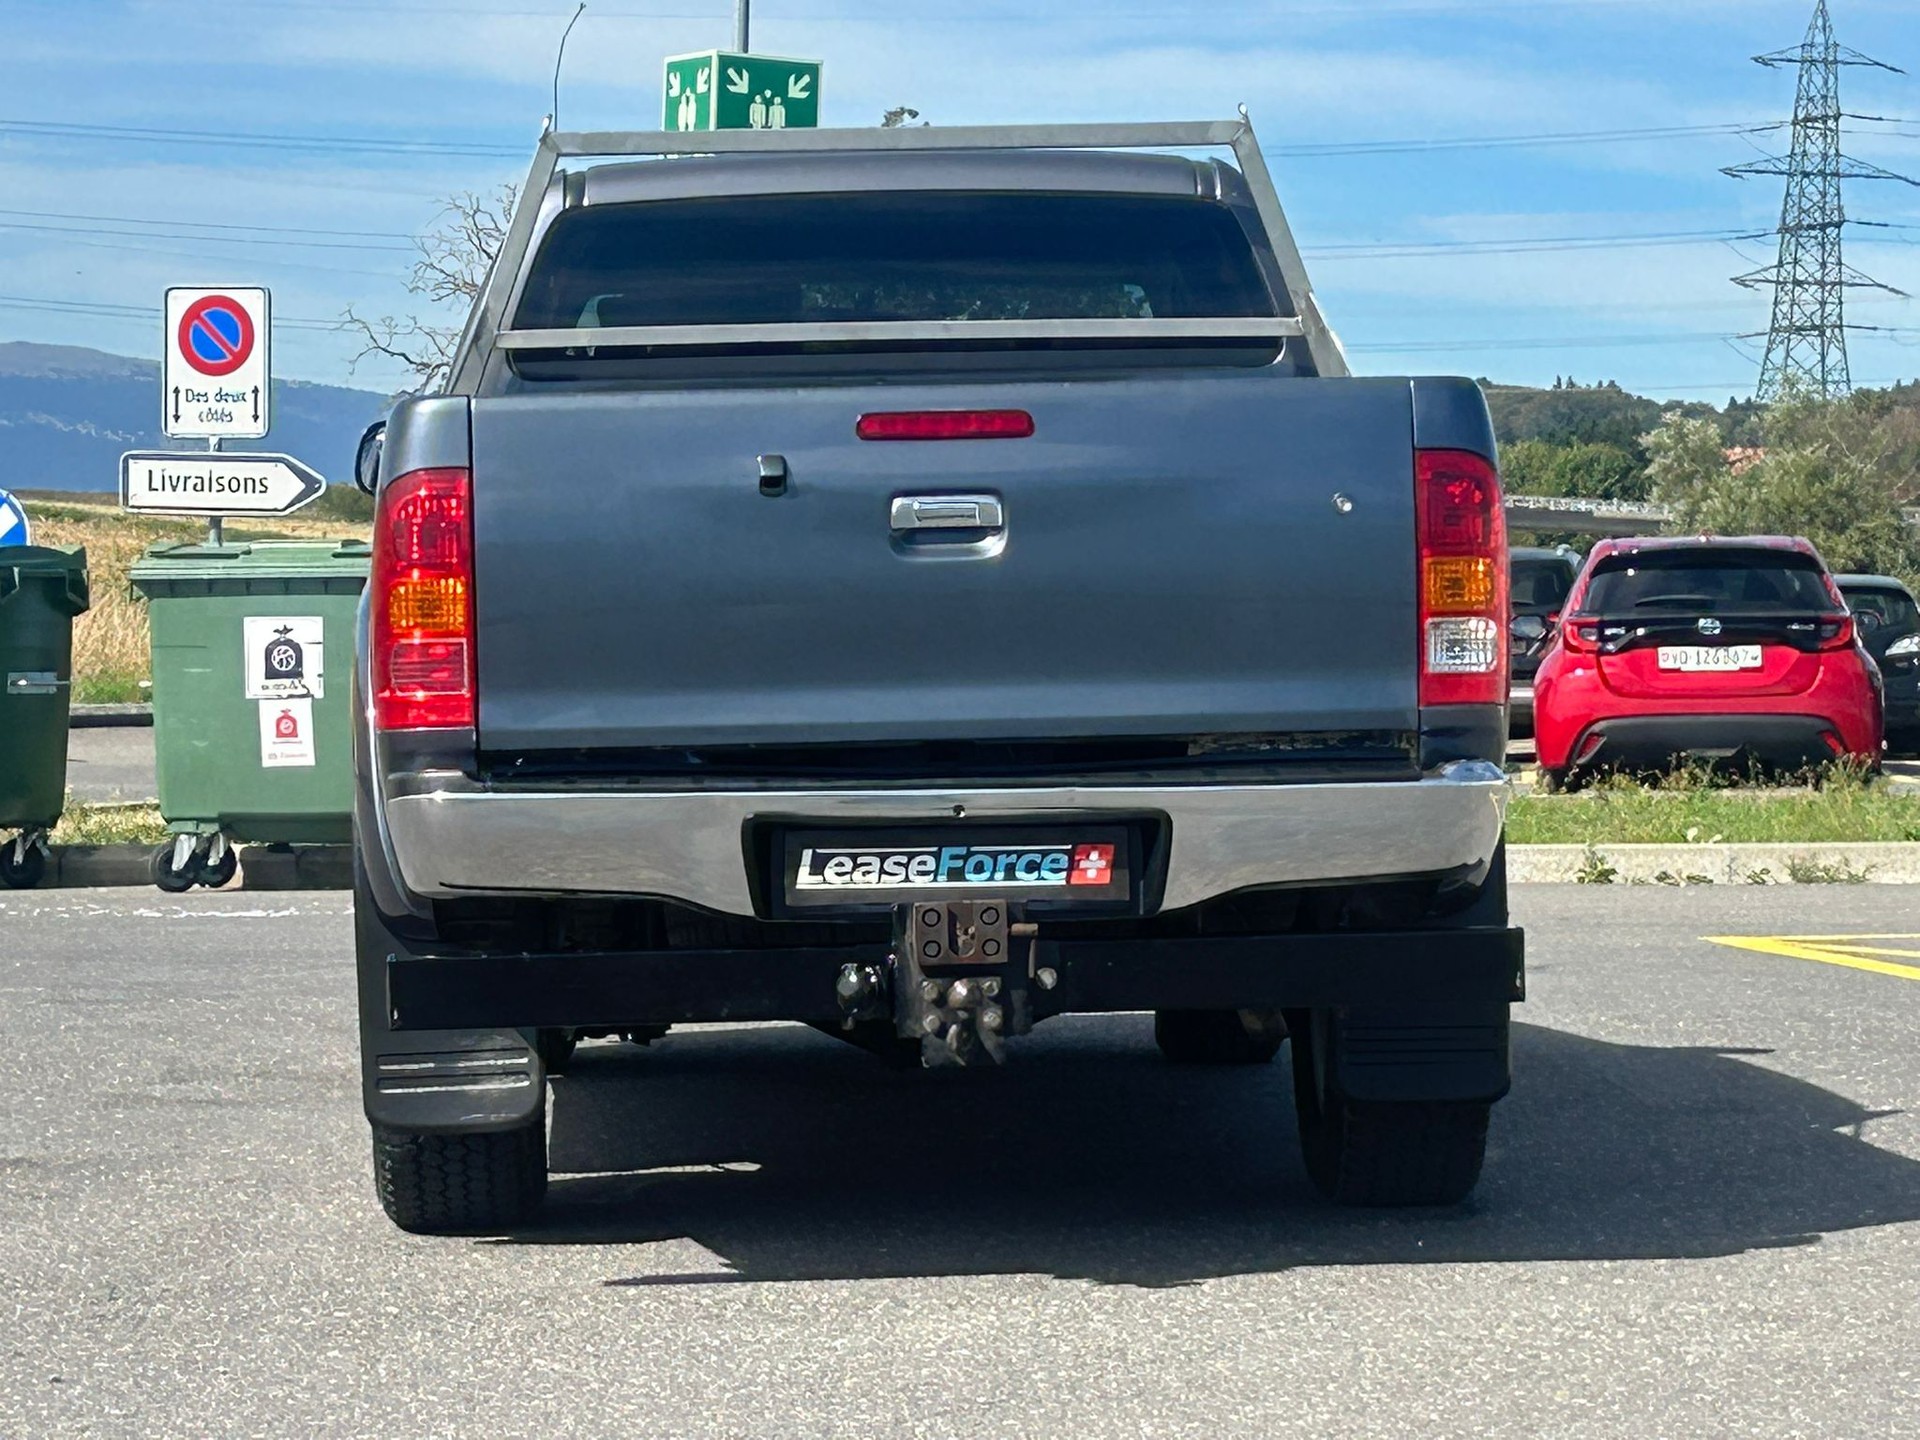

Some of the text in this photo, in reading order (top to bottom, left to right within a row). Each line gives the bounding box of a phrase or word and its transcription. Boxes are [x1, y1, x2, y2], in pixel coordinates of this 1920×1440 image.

[185, 388, 209, 403] Des
[148, 468, 269, 494] Livraisons
[797, 846, 1069, 888] LeaseForce
